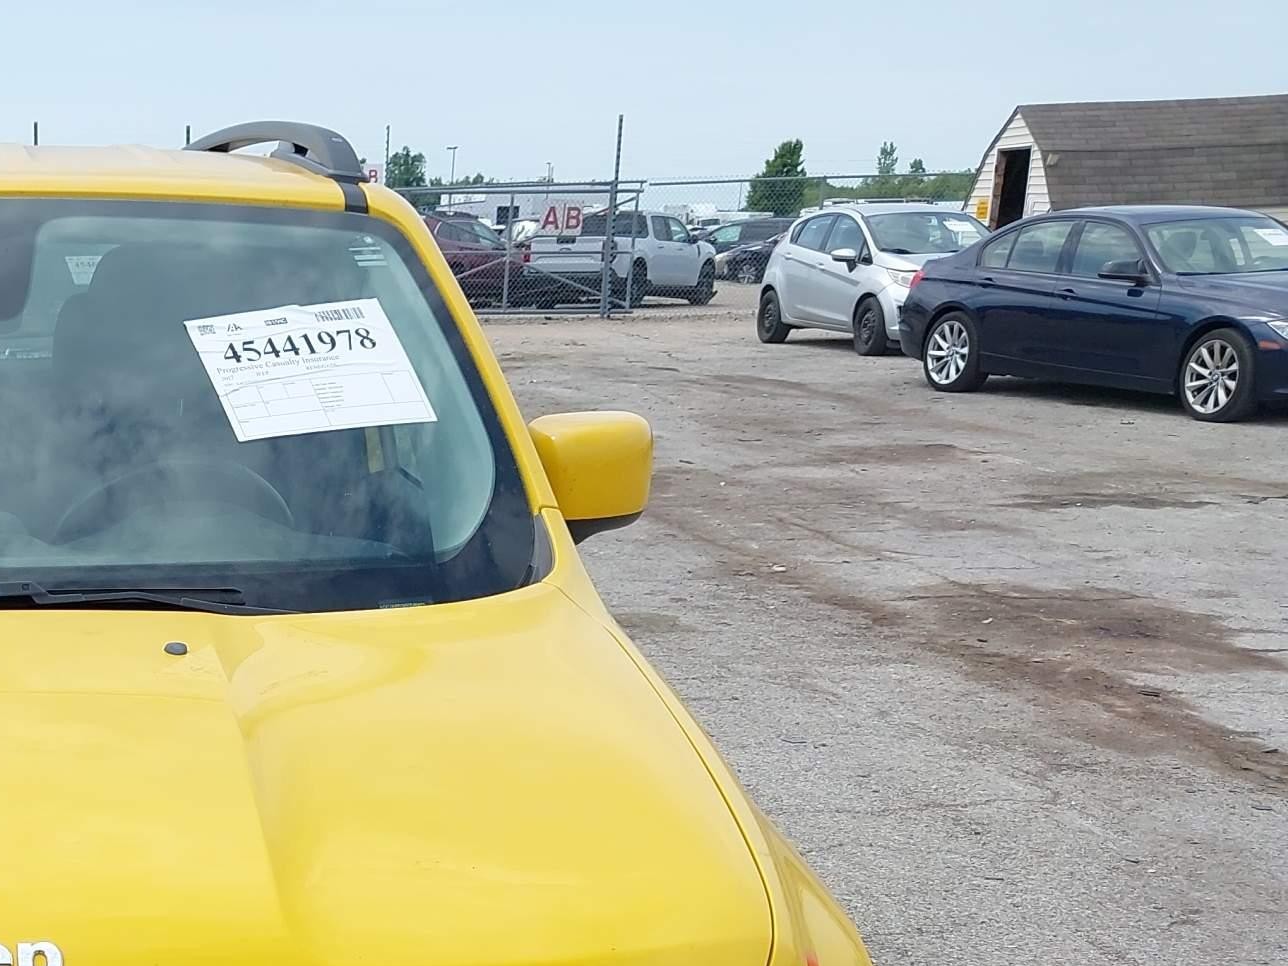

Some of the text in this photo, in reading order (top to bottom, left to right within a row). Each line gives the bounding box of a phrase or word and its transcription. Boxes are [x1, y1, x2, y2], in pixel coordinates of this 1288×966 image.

[223, 327, 377, 363] 45441978
[216, 362, 264, 376] Progressive
[265, 357, 300, 369] Casualty
[301, 355, 340, 364] Insurance
